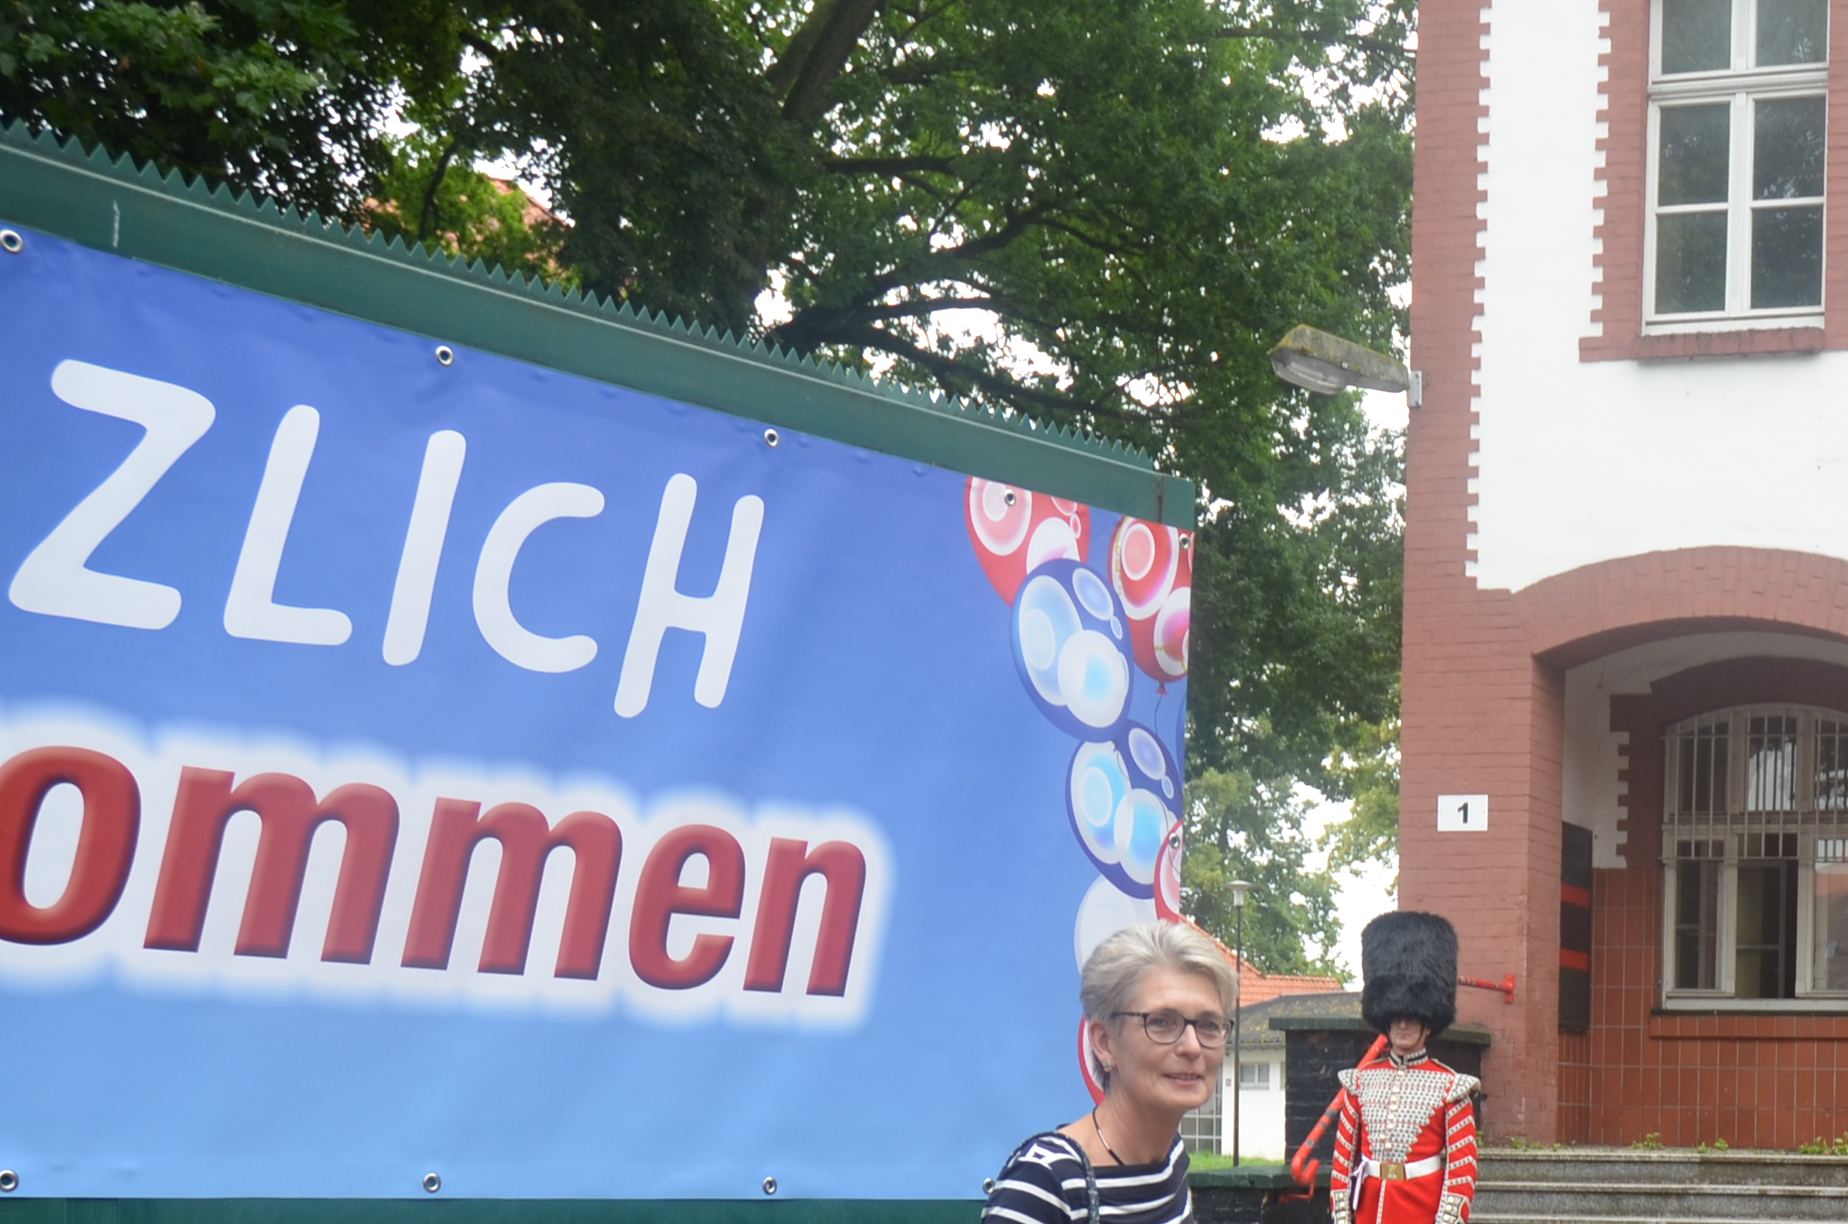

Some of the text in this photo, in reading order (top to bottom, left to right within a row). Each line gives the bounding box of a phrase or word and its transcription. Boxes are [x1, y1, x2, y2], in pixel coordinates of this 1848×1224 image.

[9, 359, 765, 719] ZLICH
[0, 745, 867, 998] ommen
[1457, 802, 1469, 824] 1
